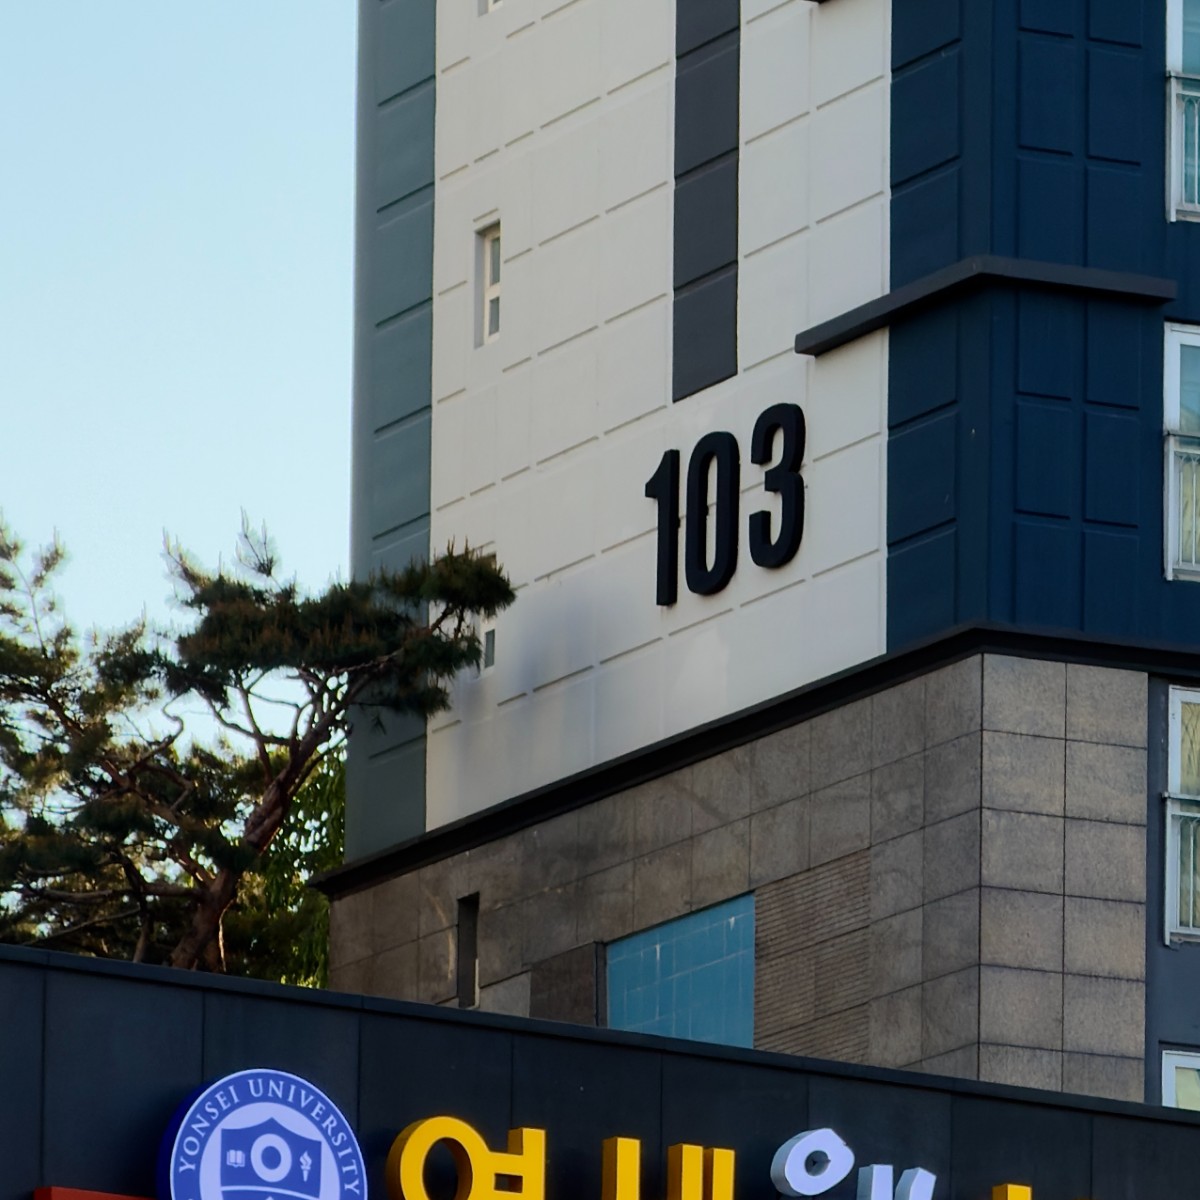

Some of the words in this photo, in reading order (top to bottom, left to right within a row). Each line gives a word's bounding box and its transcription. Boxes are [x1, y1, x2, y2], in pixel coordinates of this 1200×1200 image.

[644, 402, 806, 606] 103
[179, 1086, 240, 1174] YONSEI
[248, 1078, 360, 1195] UNIVERSITY
